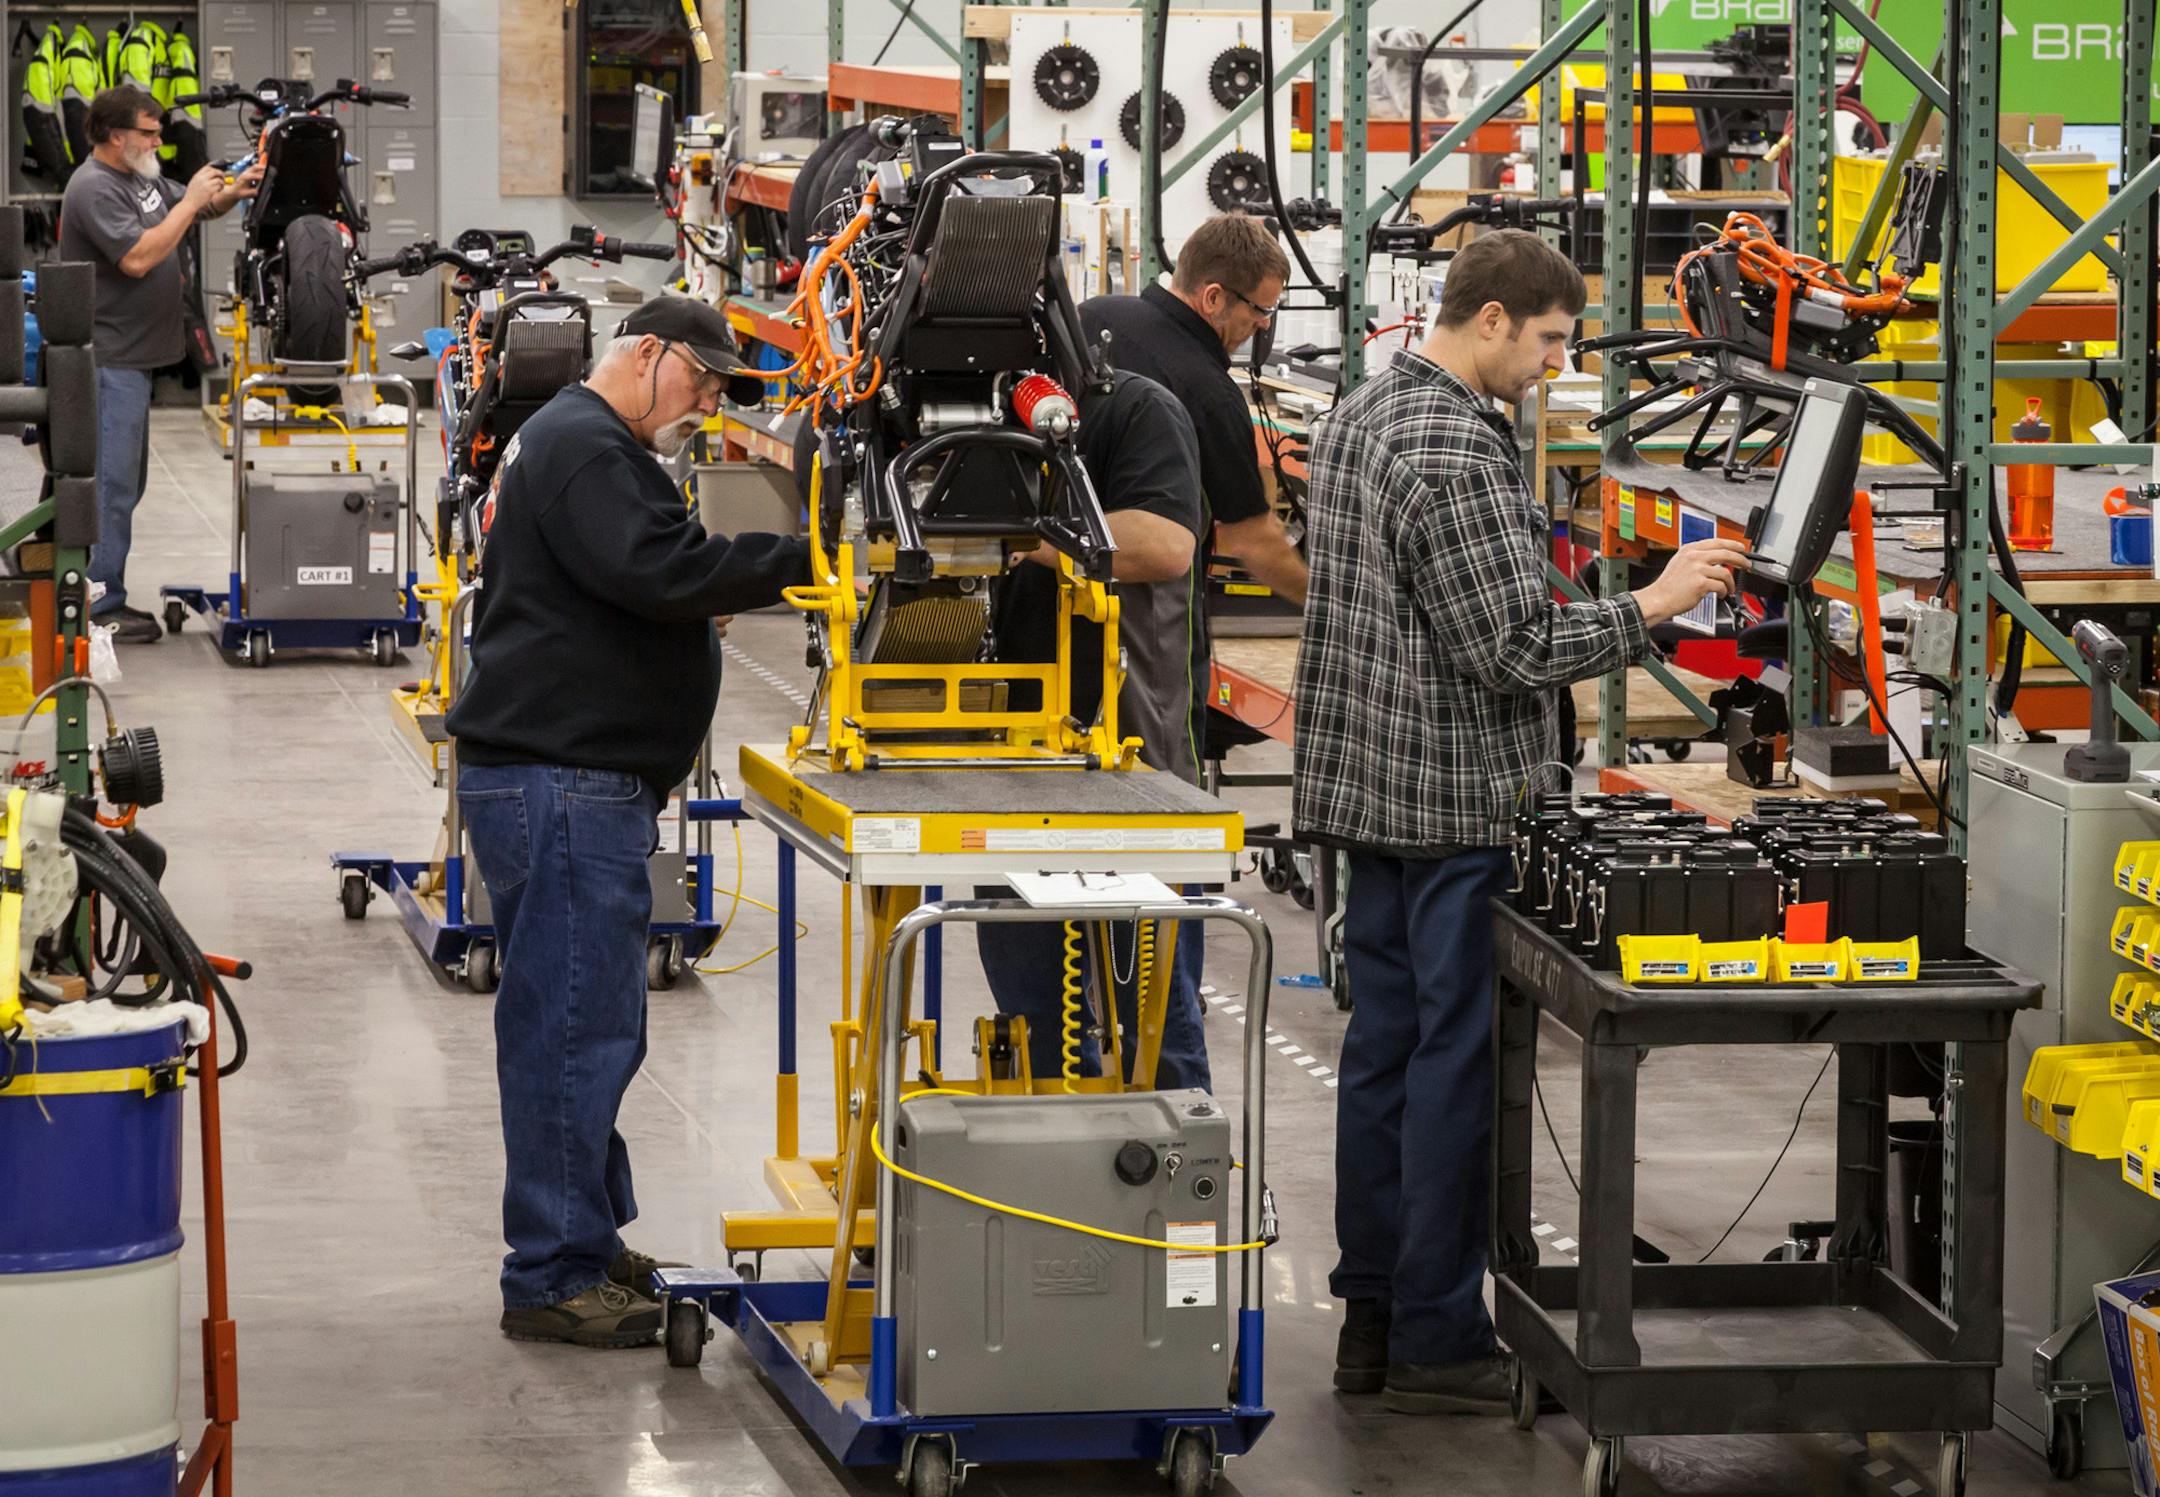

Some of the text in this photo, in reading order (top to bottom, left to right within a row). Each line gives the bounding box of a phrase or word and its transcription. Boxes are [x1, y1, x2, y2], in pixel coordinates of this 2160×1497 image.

[300, 571, 348, 581] CART #1
[11, 760, 46, 778] ACE
[2134, 1328, 2146, 1371] Box
